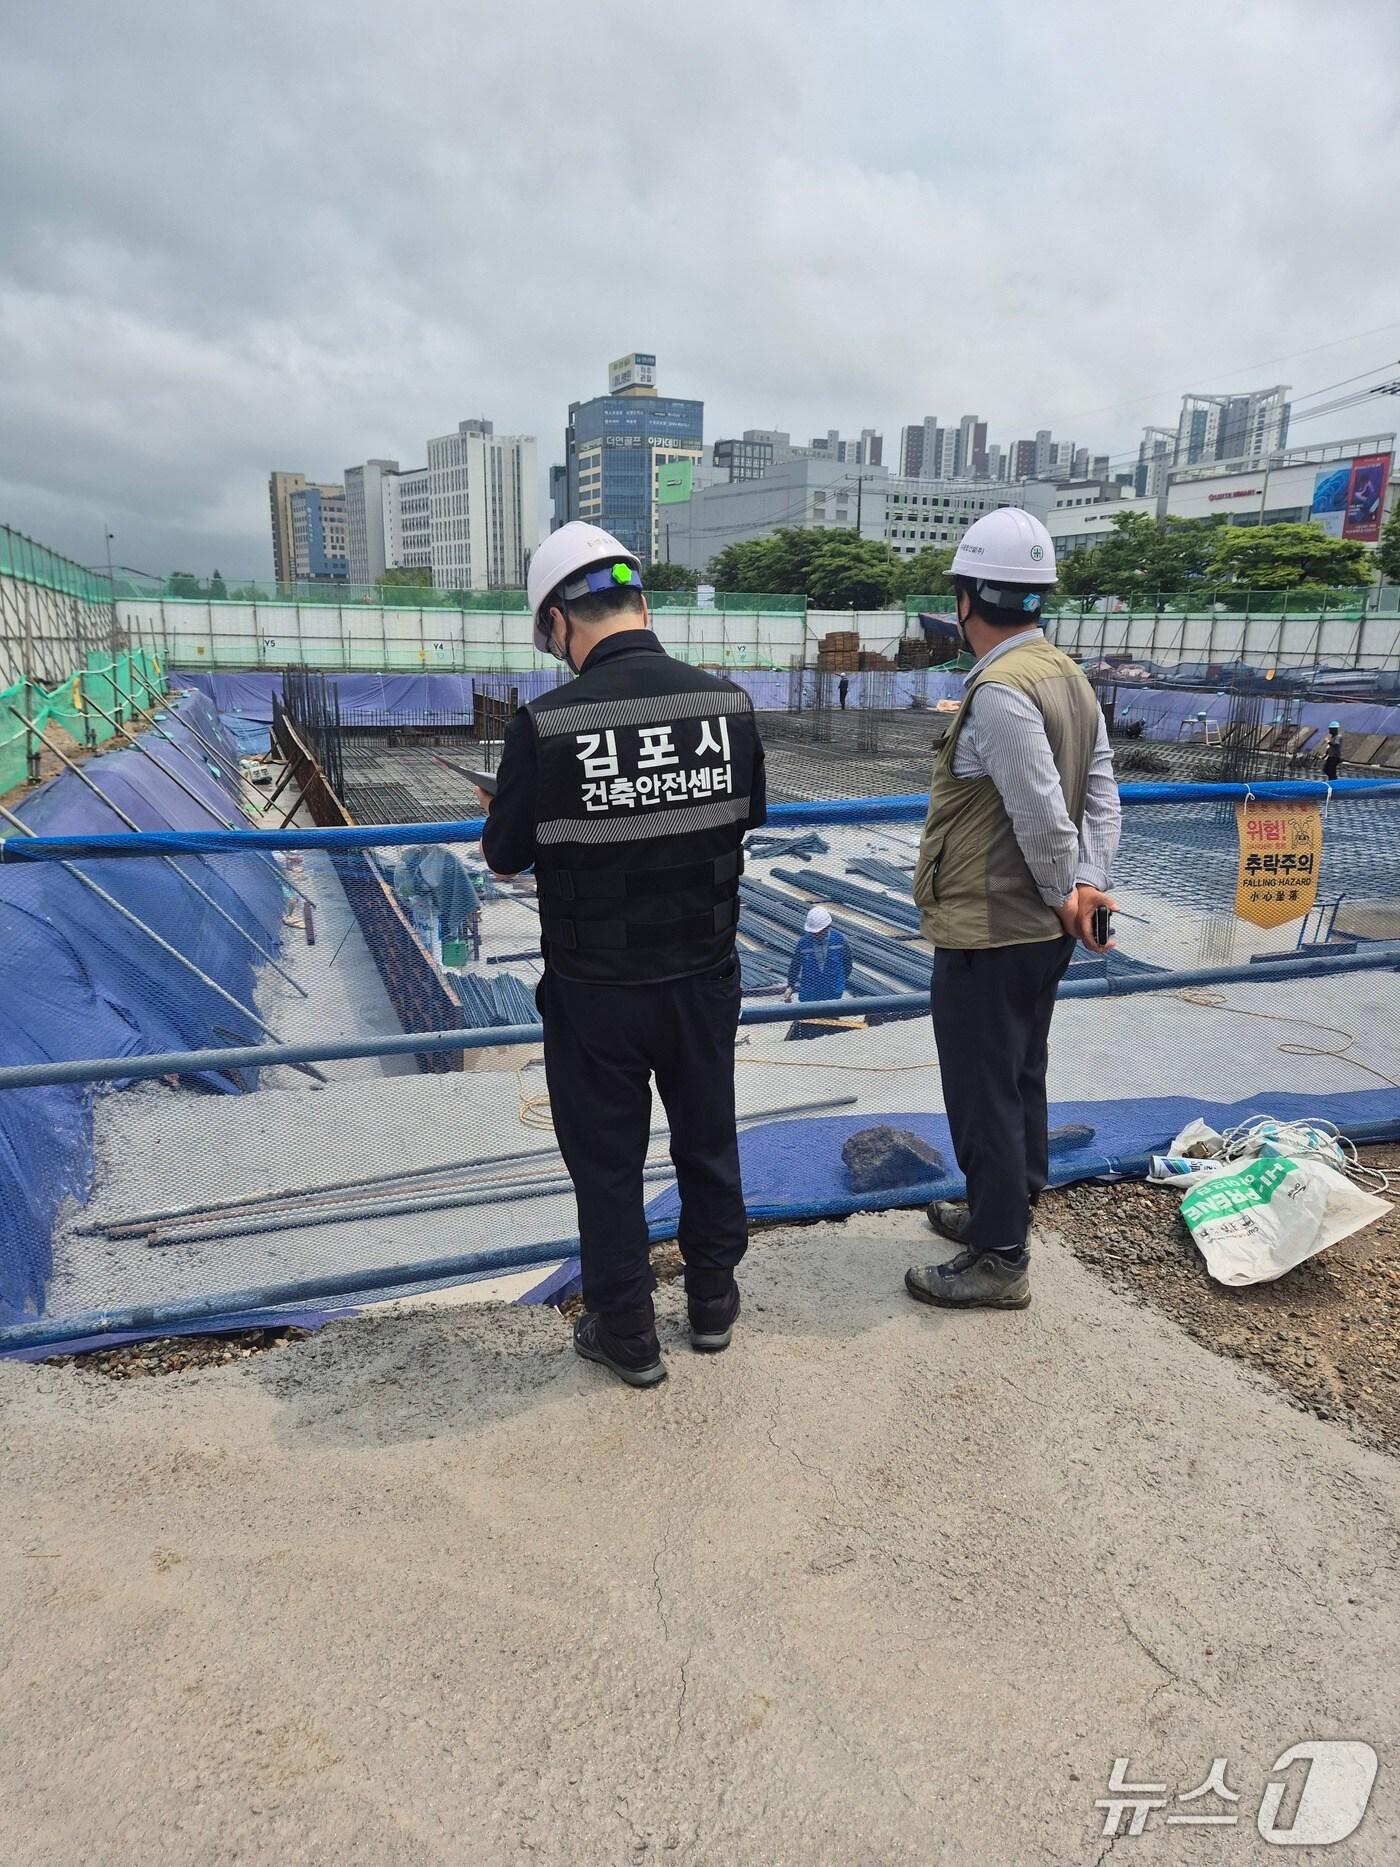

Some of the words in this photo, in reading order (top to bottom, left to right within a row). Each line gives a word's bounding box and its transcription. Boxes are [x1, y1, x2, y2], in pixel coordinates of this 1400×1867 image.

[647, 436, 682, 448] 아카데미
[264, 639, 276, 648] Y5
[433, 642, 444, 650] Y4
[580, 763, 733, 812] 건축안전센터
[1246, 820, 1287, 841] 위험!
[1244, 852, 1314, 876] 추락주의
[1242, 878, 1277, 888] FALLING
[1278, 877, 1312, 887] HAZARD
[1183, 1162, 1285, 1223] HI-PRENE
